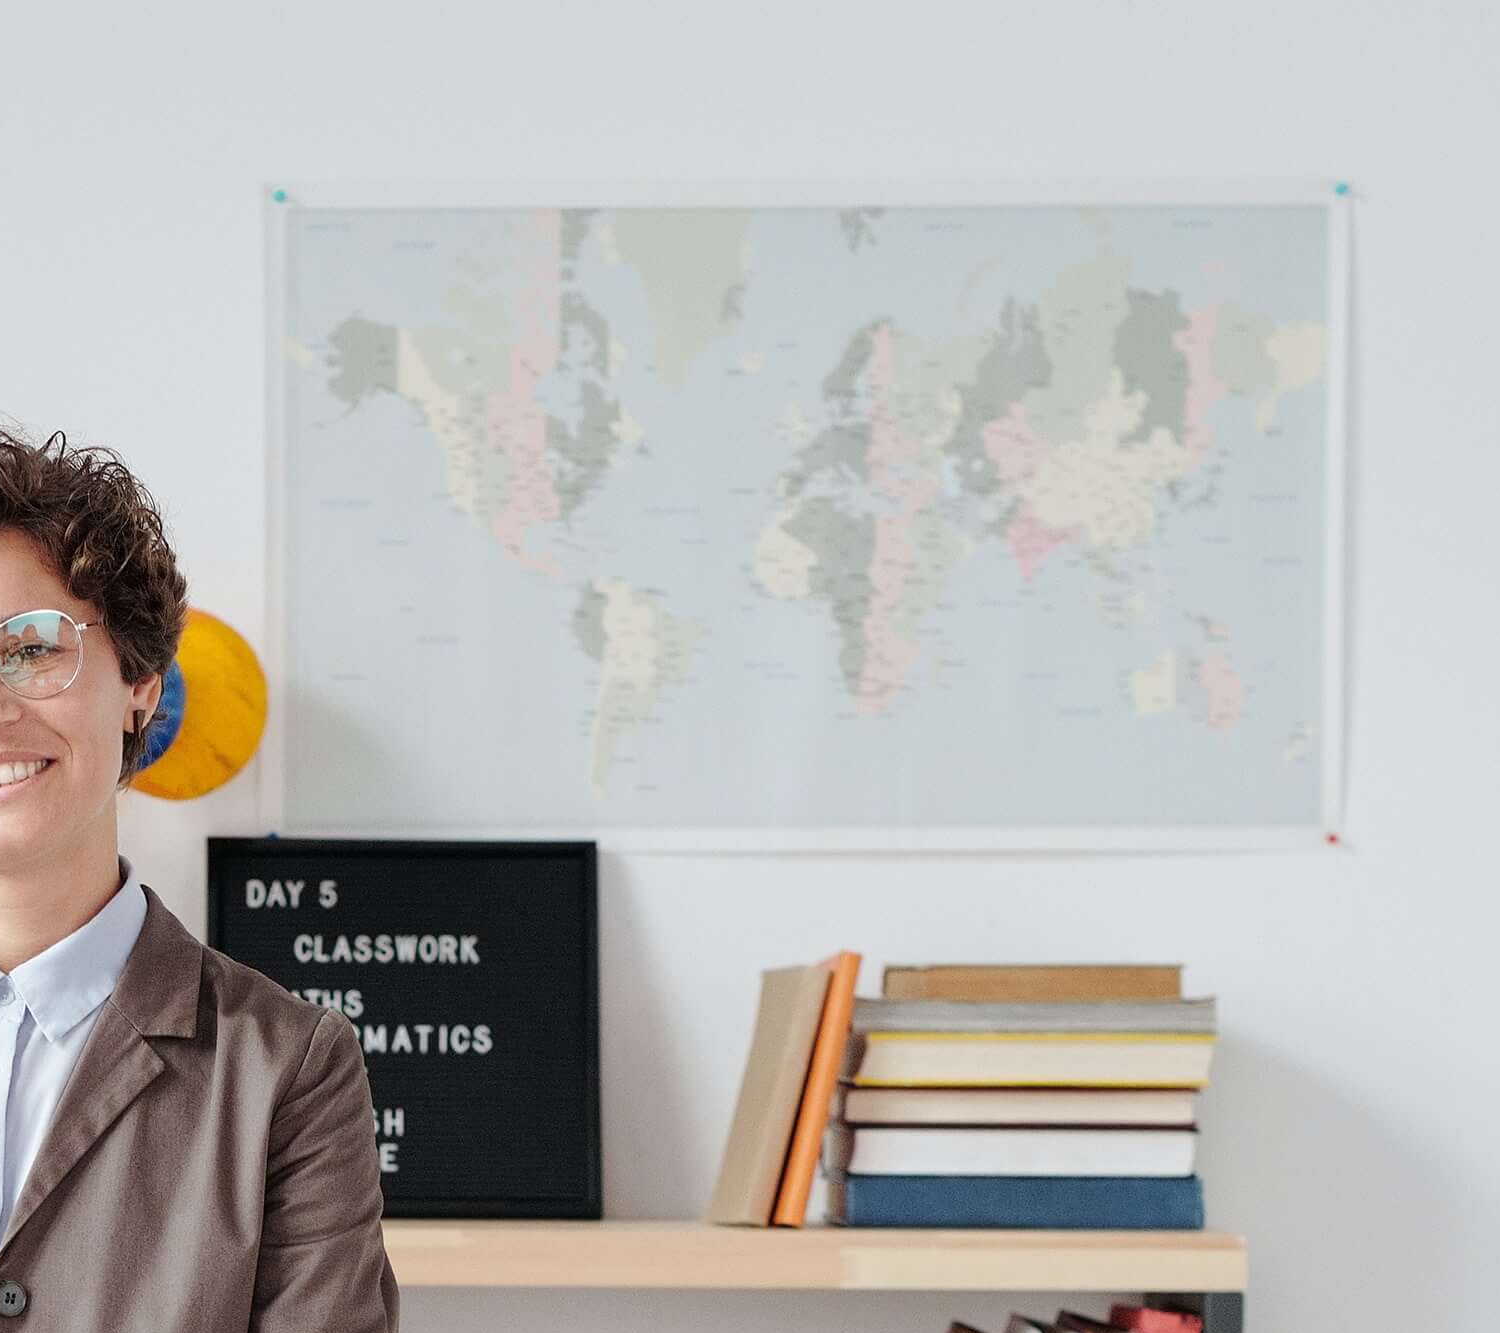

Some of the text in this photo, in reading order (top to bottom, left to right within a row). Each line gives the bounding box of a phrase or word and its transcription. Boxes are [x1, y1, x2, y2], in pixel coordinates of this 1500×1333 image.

[245, 879, 338, 909] DAY 5
[293, 934, 480, 964] CLASSWORK
[291, 988, 364, 1019] THS
[353, 1023, 493, 1054] MATICS
